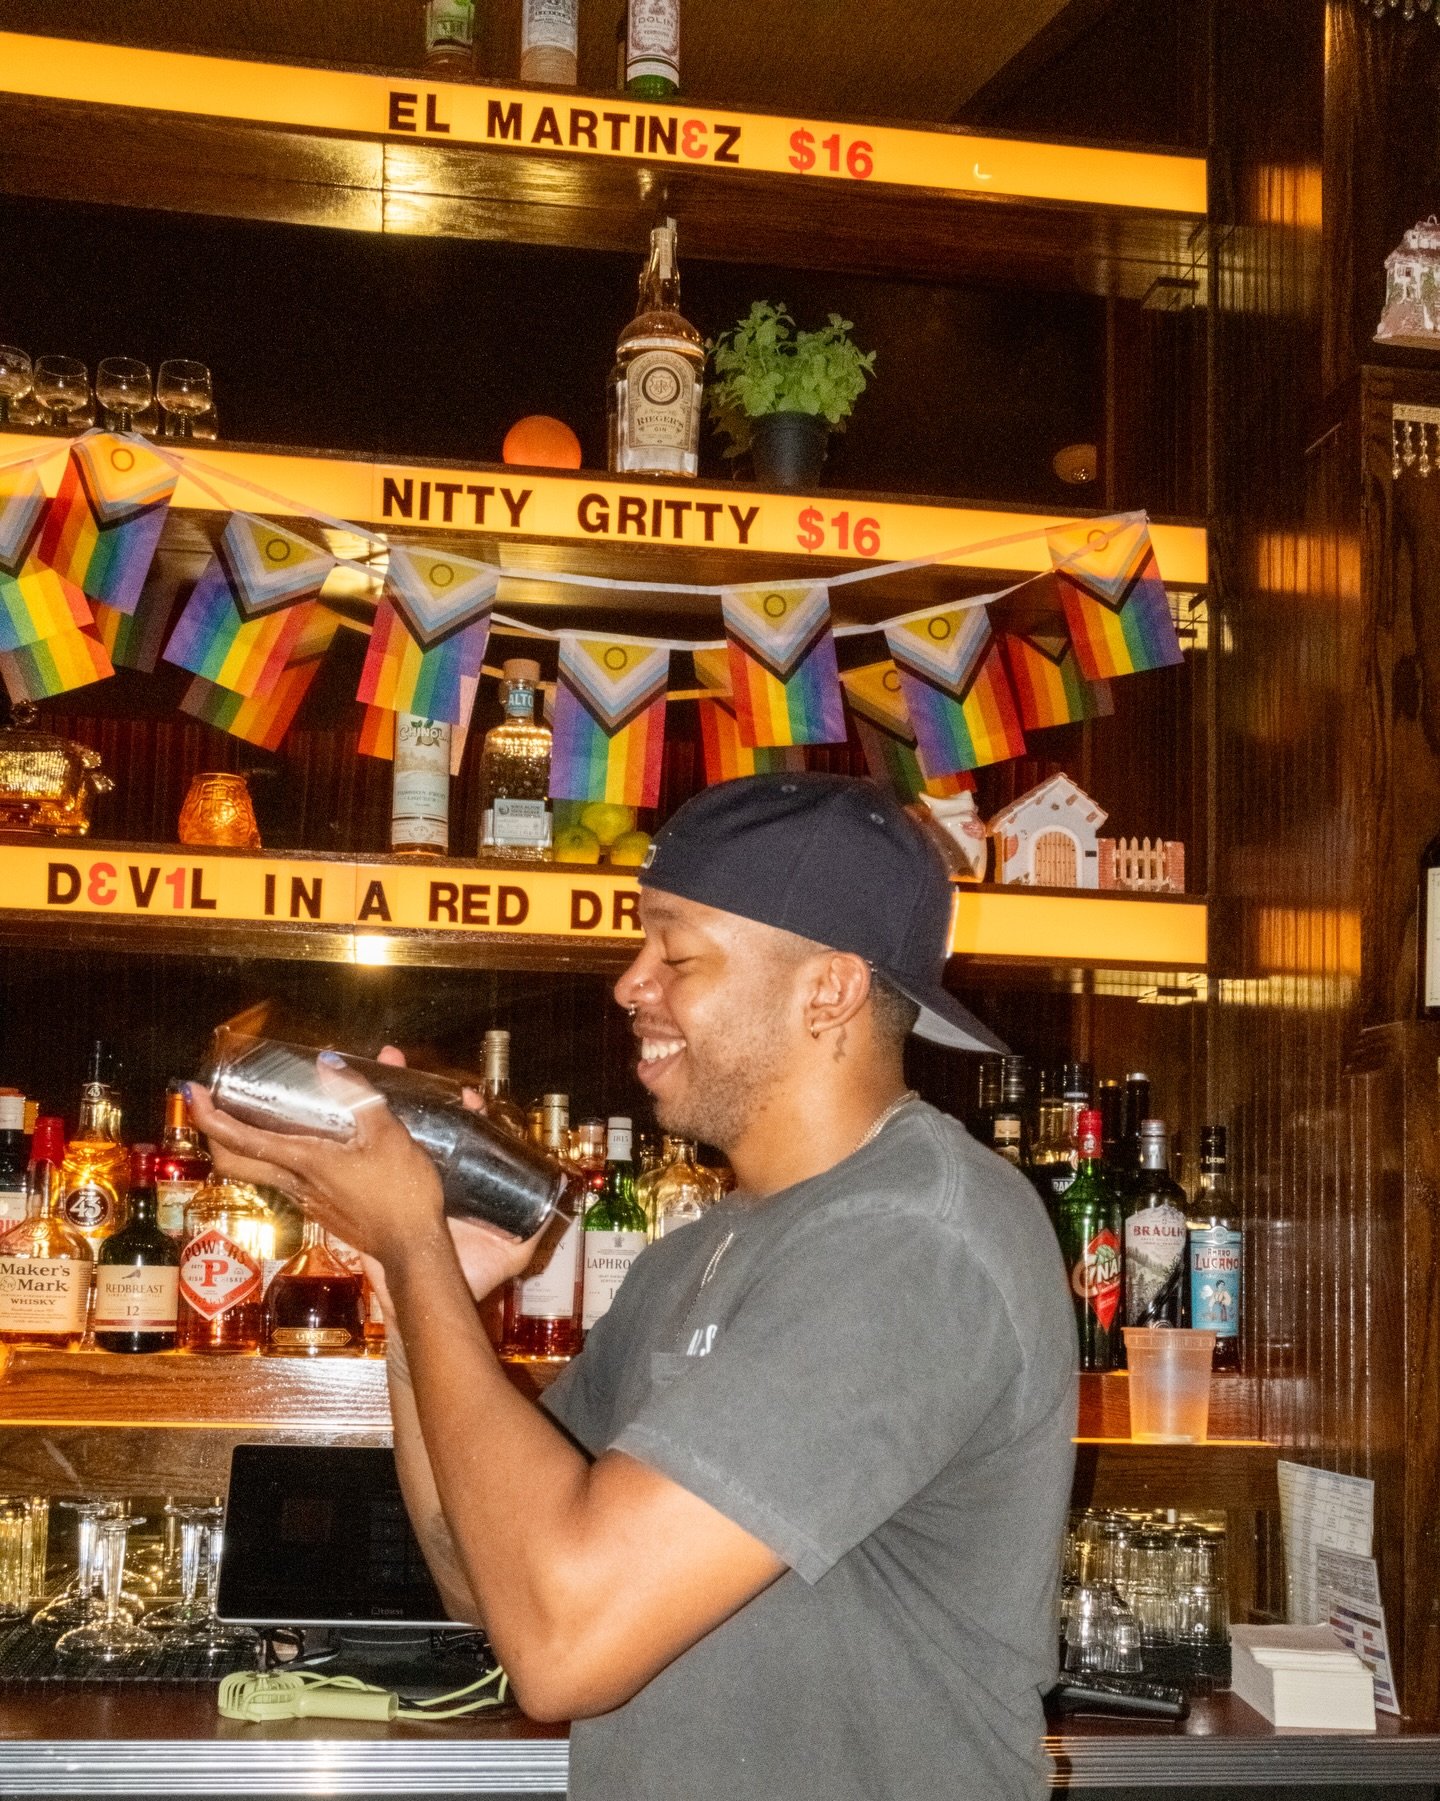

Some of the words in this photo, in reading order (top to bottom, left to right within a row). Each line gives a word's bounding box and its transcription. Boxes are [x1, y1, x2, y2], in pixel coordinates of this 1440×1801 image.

[388, 92, 450, 134] EL
[788, 127, 874, 180] $16
[382, 477, 533, 528] NITTY
[578, 493, 760, 545] GRITTY
[796, 505, 881, 557] $16
[264, 874, 323, 919] IN
[357, 880, 392, 922] A
[428, 881, 529, 926] RED
[70, 1195, 101, 1218] 43
[0, 1263, 71, 1277] Maker's
[1195, 1253, 1239, 1271] LUCANO
[201, 1259, 229, 1287] P
[17, 1278, 69, 1292] Mark
[105, 1284, 164, 1294] REDBREAST
[127, 1306, 140, 1316] 12
